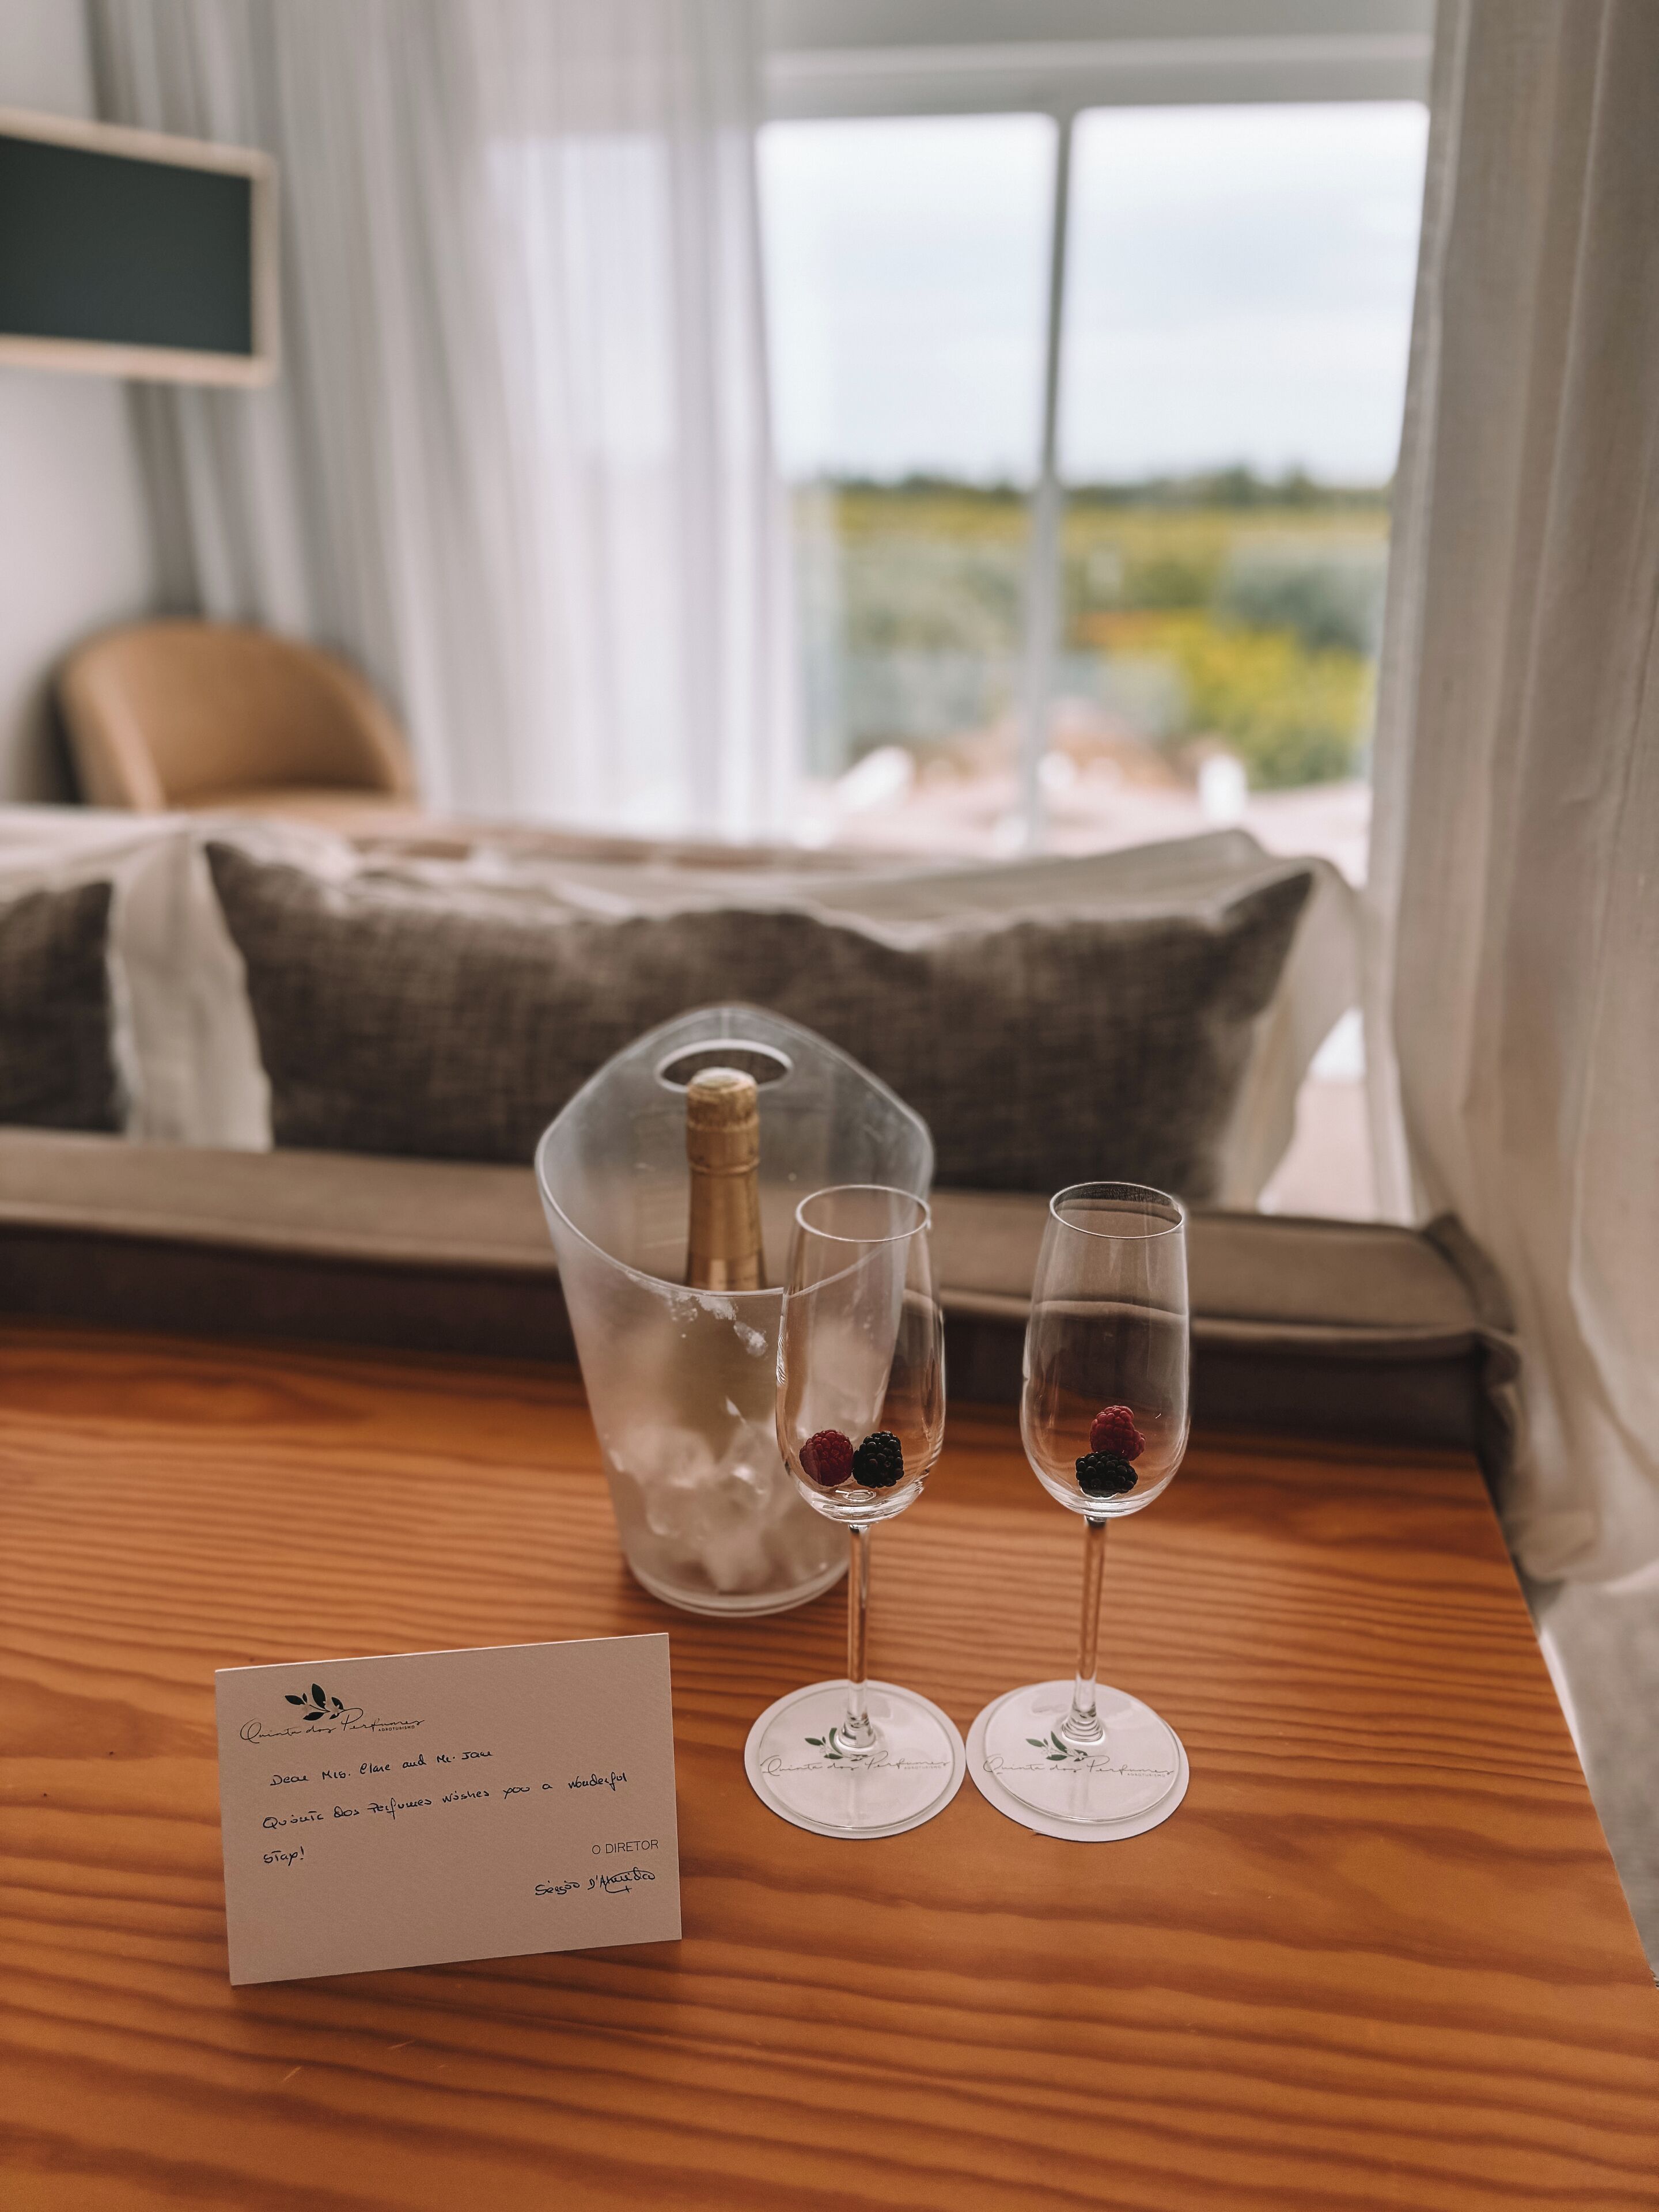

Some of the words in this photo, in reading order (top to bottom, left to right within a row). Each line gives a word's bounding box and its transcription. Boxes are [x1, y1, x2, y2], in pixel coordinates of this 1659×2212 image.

[270, 1774, 309, 1786] Dear
[403, 1753, 427, 1768] and
[503, 1786, 531, 1800] you
[592, 1844, 601, 1854] O
[605, 1839, 659, 1854] DIRETOR
